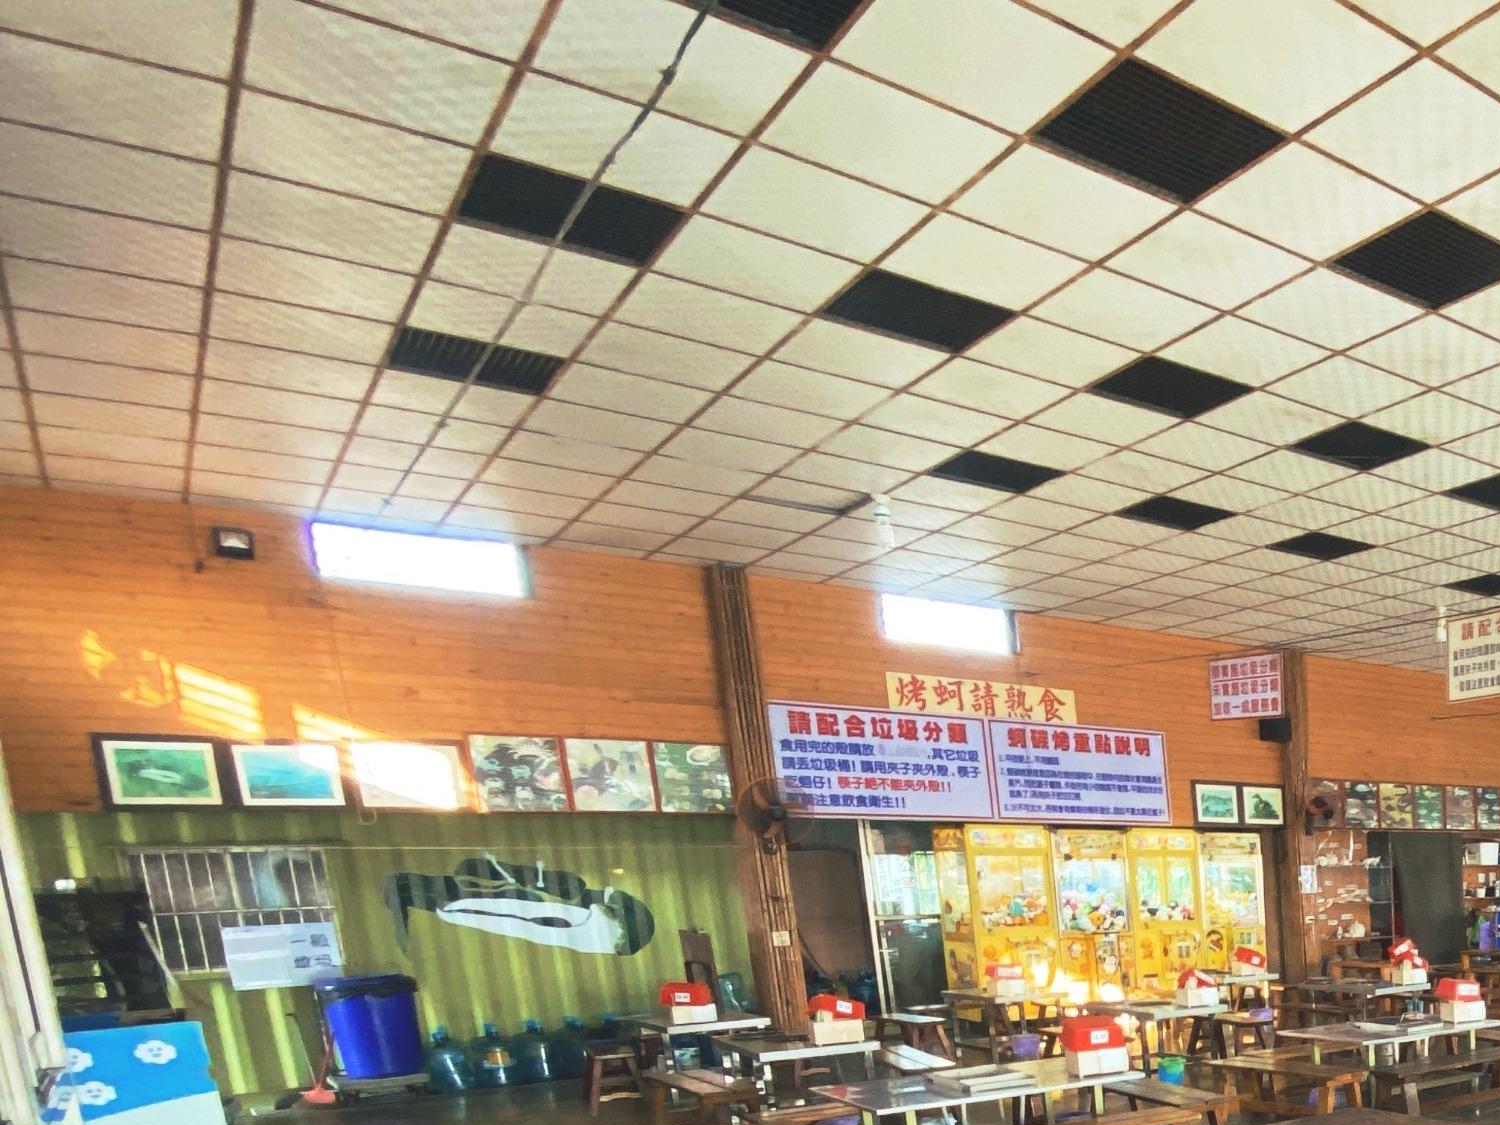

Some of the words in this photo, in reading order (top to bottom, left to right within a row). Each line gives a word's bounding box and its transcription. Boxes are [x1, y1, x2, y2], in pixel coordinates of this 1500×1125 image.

[896, 675, 1066, 722] 烤蚵請熟食
[787, 710, 968, 744] 請配合垃圾分類
